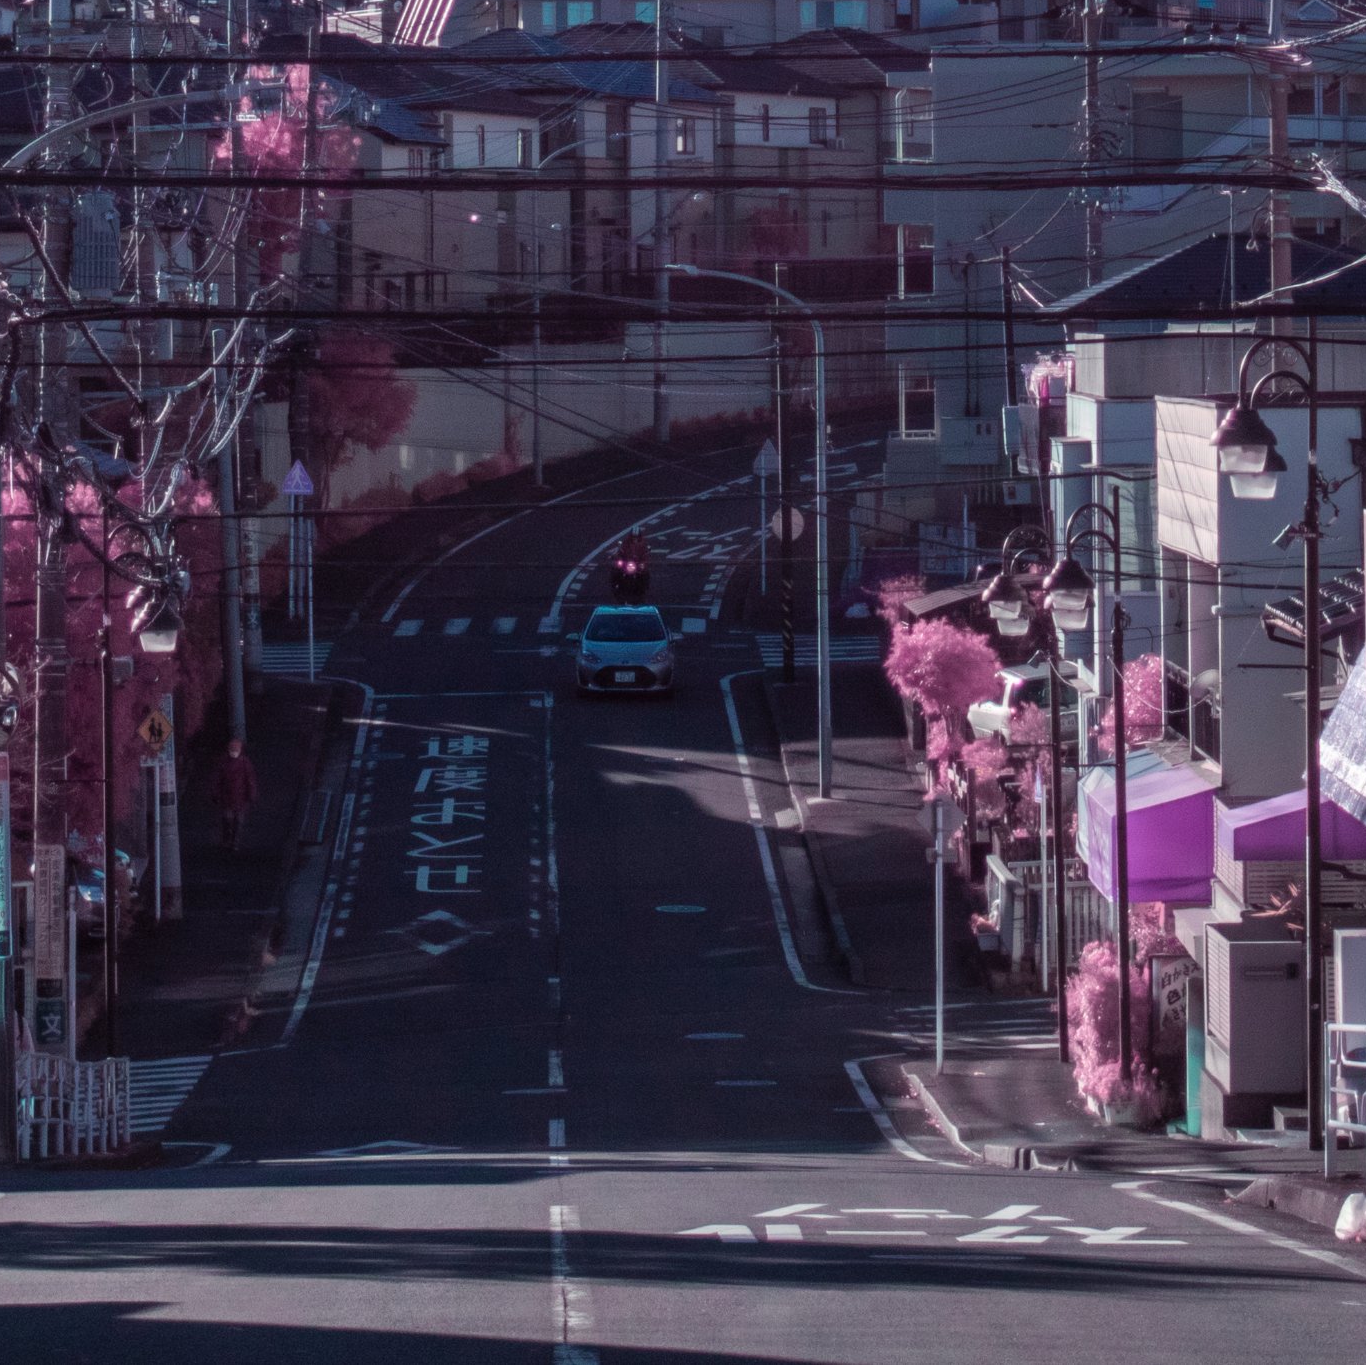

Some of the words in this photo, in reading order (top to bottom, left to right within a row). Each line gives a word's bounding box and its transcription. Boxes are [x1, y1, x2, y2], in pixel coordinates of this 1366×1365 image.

[403, 735, 490, 893] 速度おとせ
[675, 1224, 1190, 1244] スクール
